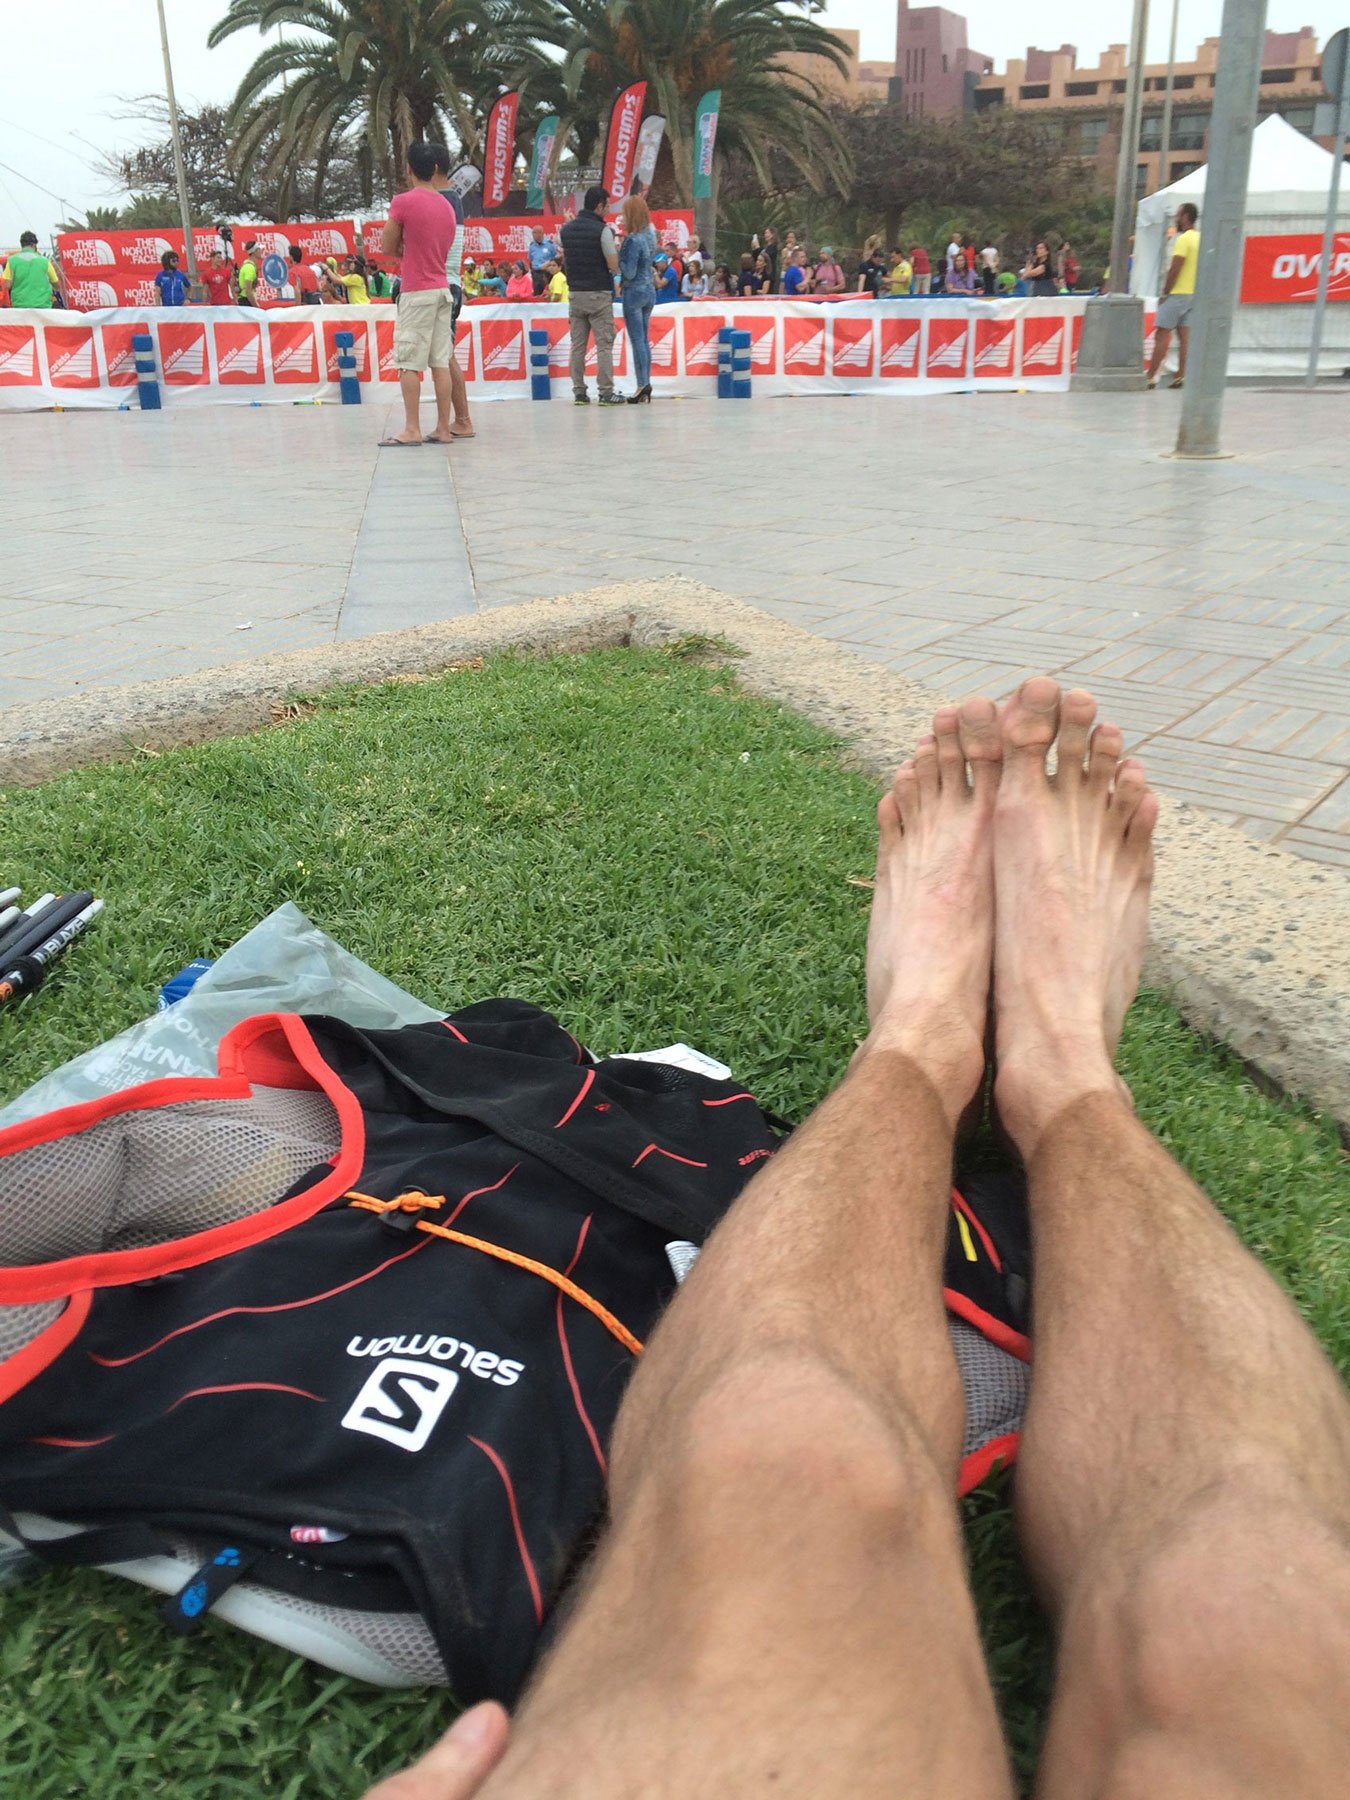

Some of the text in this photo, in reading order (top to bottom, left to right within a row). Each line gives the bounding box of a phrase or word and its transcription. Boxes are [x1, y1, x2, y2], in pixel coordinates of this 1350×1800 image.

[312, 230, 331, 240] THE
[509, 225, 524, 235] THE
[195, 235, 215, 244] THE
[255, 232, 274, 241] THE
[498, 234, 524, 244] NORTH
[75, 240, 95, 249] THE
[135, 238, 155, 247] THE
[298, 238, 331, 248] NORTH
[63, 247, 96, 260] NORTH
[121, 246, 155, 257] NORTH
[308, 246, 332, 256] FACE
[73, 257, 96, 267] FACE
[132, 255, 156, 265] FACE
[1271, 252, 1350, 279] OVR
[79, 281, 98, 289] THE
[67, 288, 98, 298] NORTH
[74, 296, 98, 306] FACE
[43, 918, 85, 954] BLAZE
